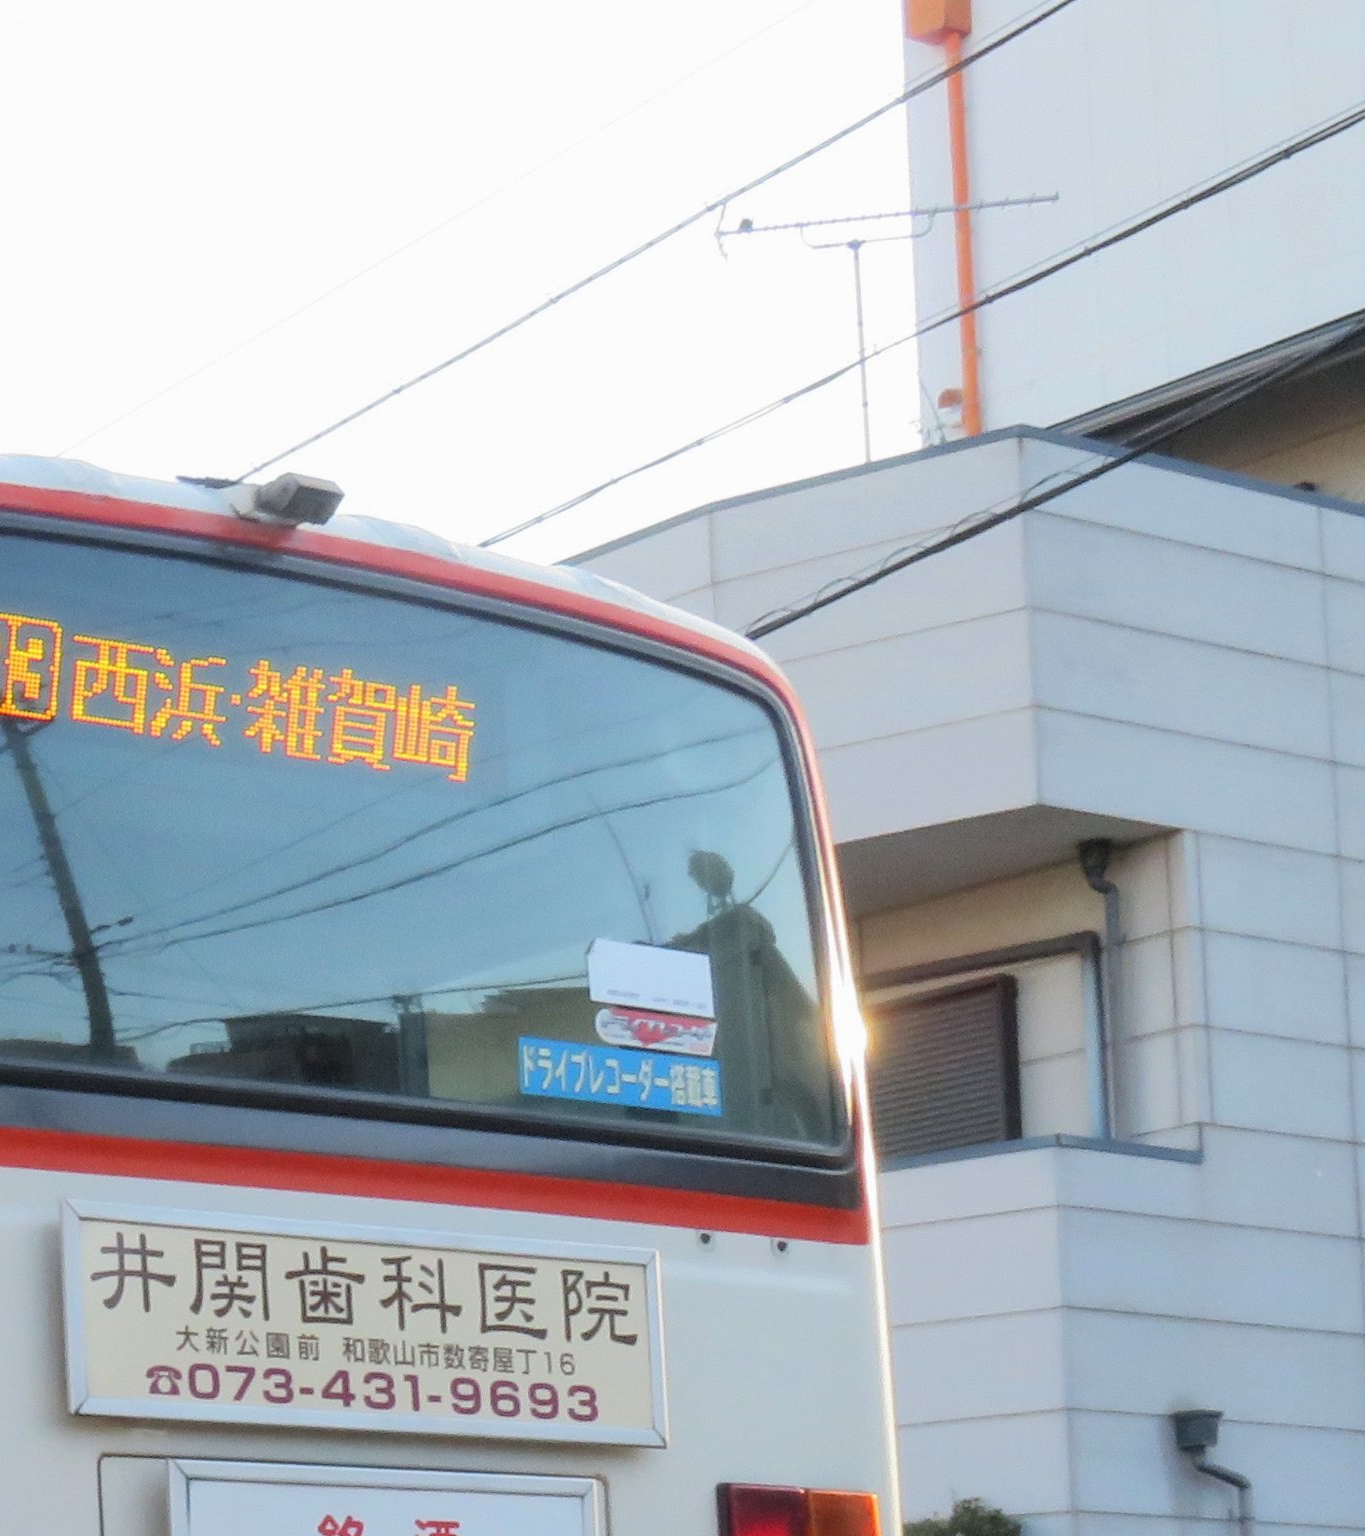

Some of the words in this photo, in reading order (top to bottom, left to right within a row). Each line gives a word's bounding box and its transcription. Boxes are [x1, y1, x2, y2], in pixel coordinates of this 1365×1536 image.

[90, 1232, 640, 1346] 井関歯科医院
[175, 1325, 321, 1363] 大新公園前
[342, 1336, 576, 1376] 和歌山市数寄屋丁16
